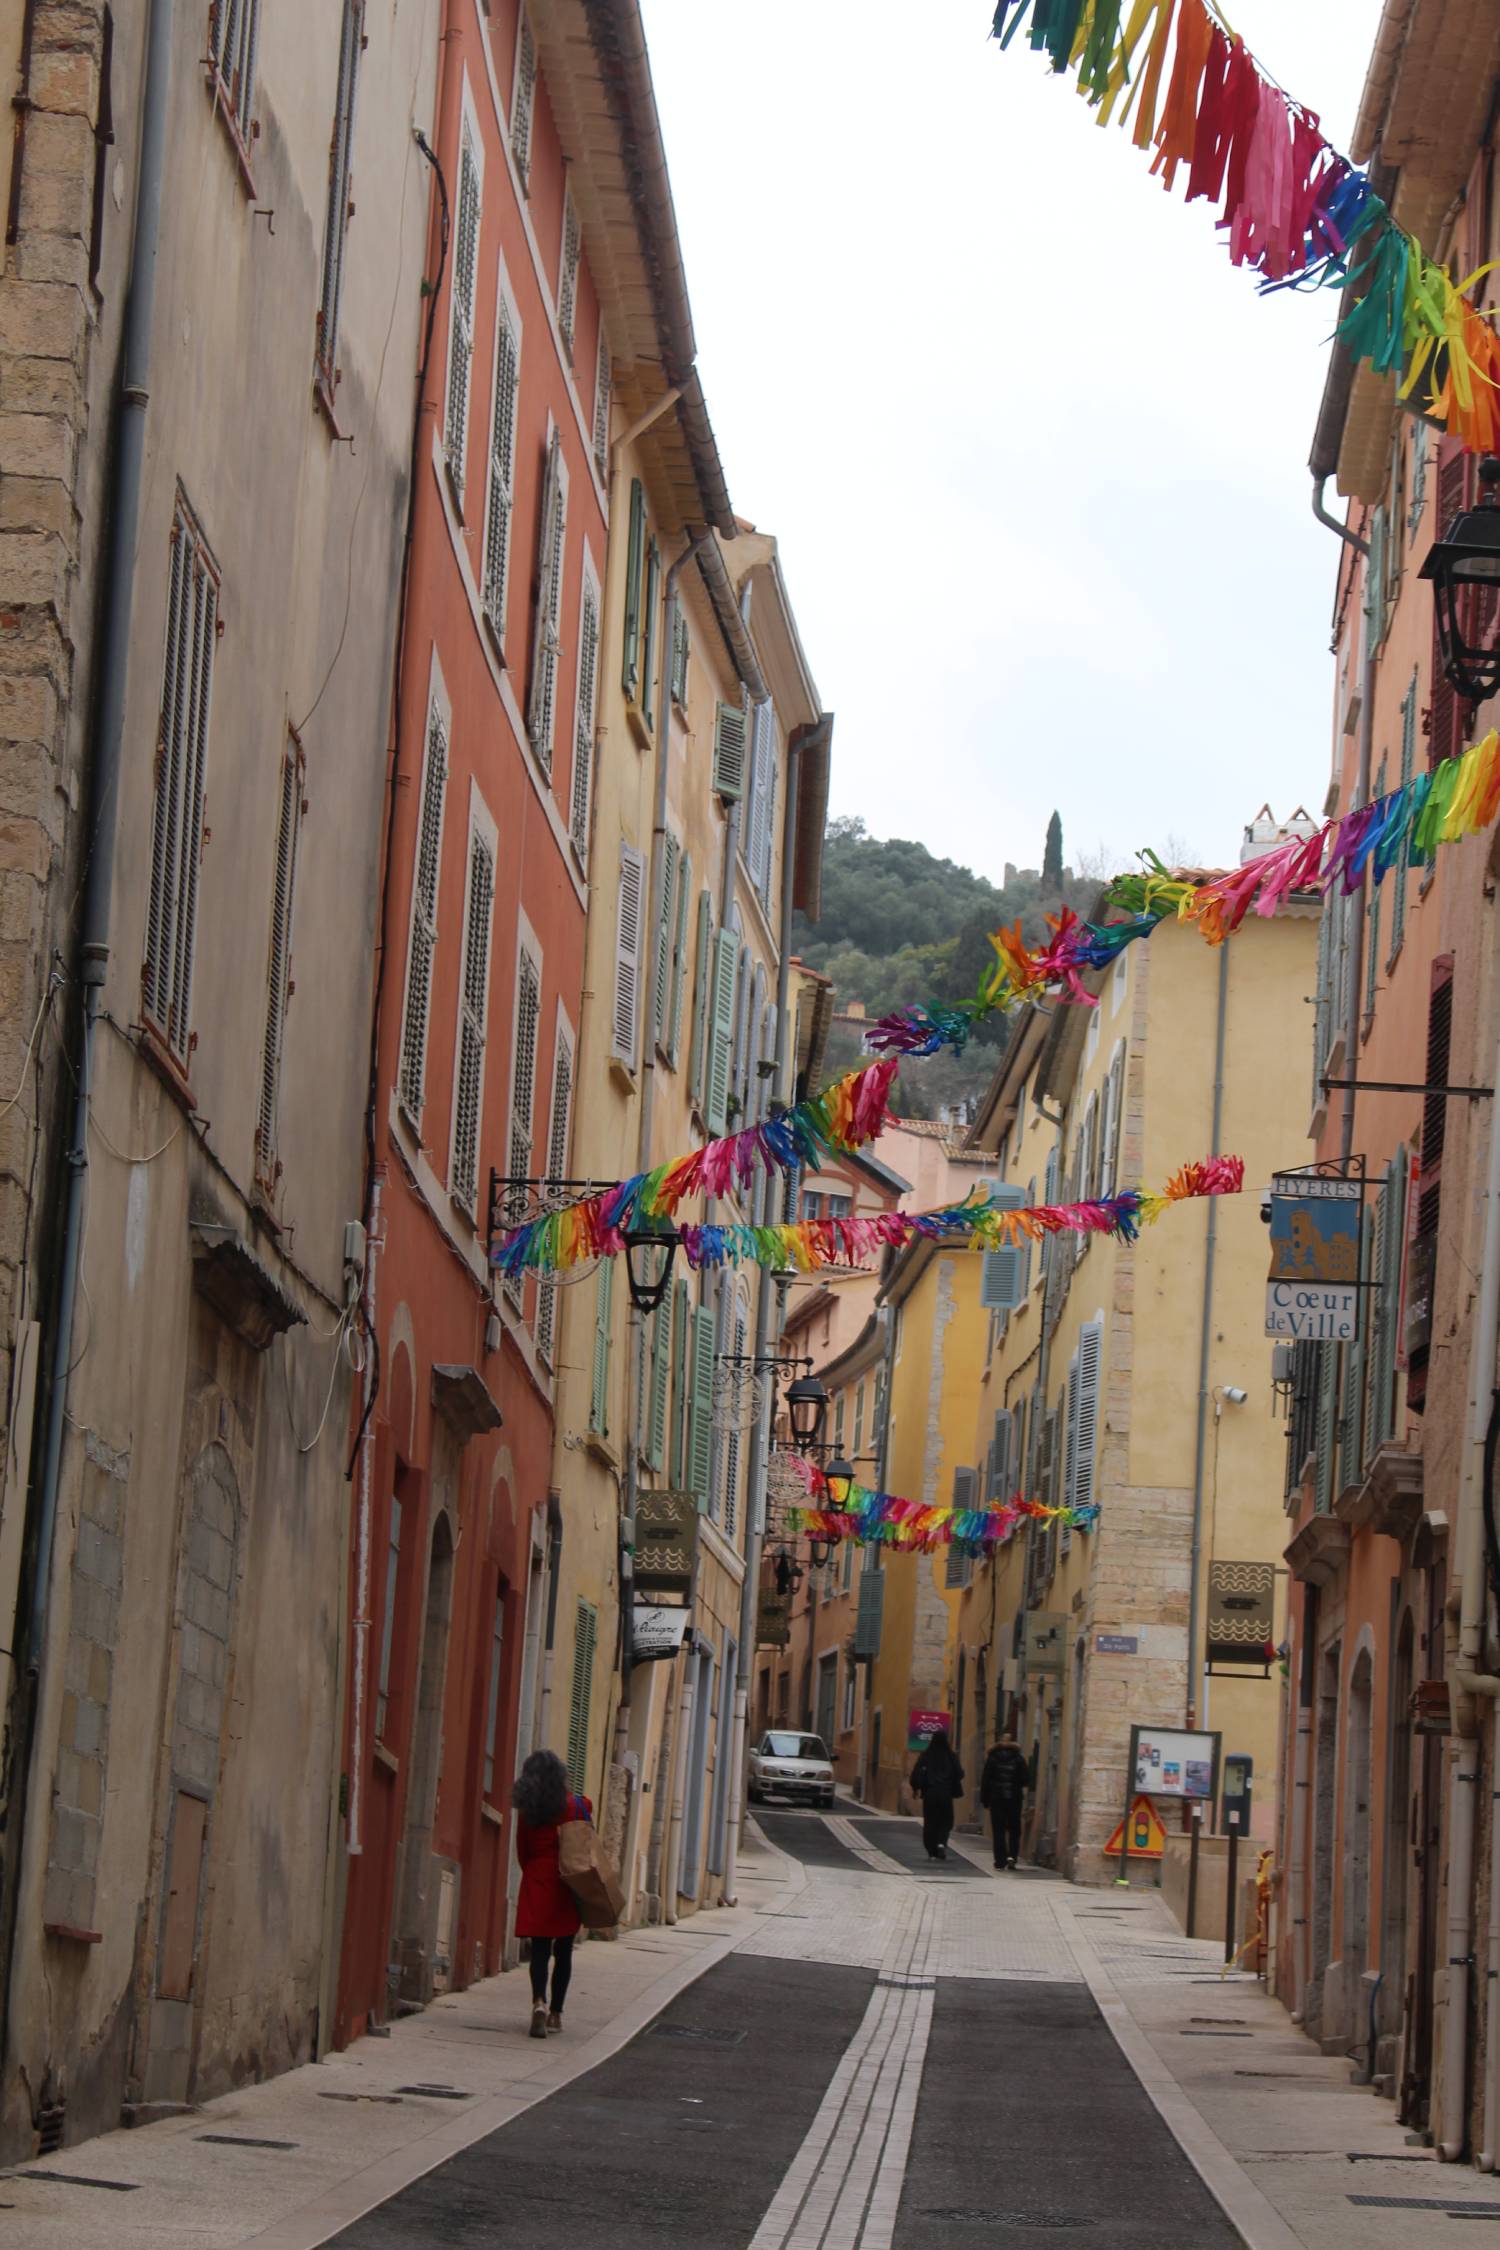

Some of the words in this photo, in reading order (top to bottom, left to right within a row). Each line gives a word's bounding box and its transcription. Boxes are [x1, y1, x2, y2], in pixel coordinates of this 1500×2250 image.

[1275, 1178, 1357, 1197] HYERES
[1273, 1282, 1352, 1310] Cœur
[1265, 1311, 1285, 1330] de
[1286, 1312, 1351, 1338] Ville
